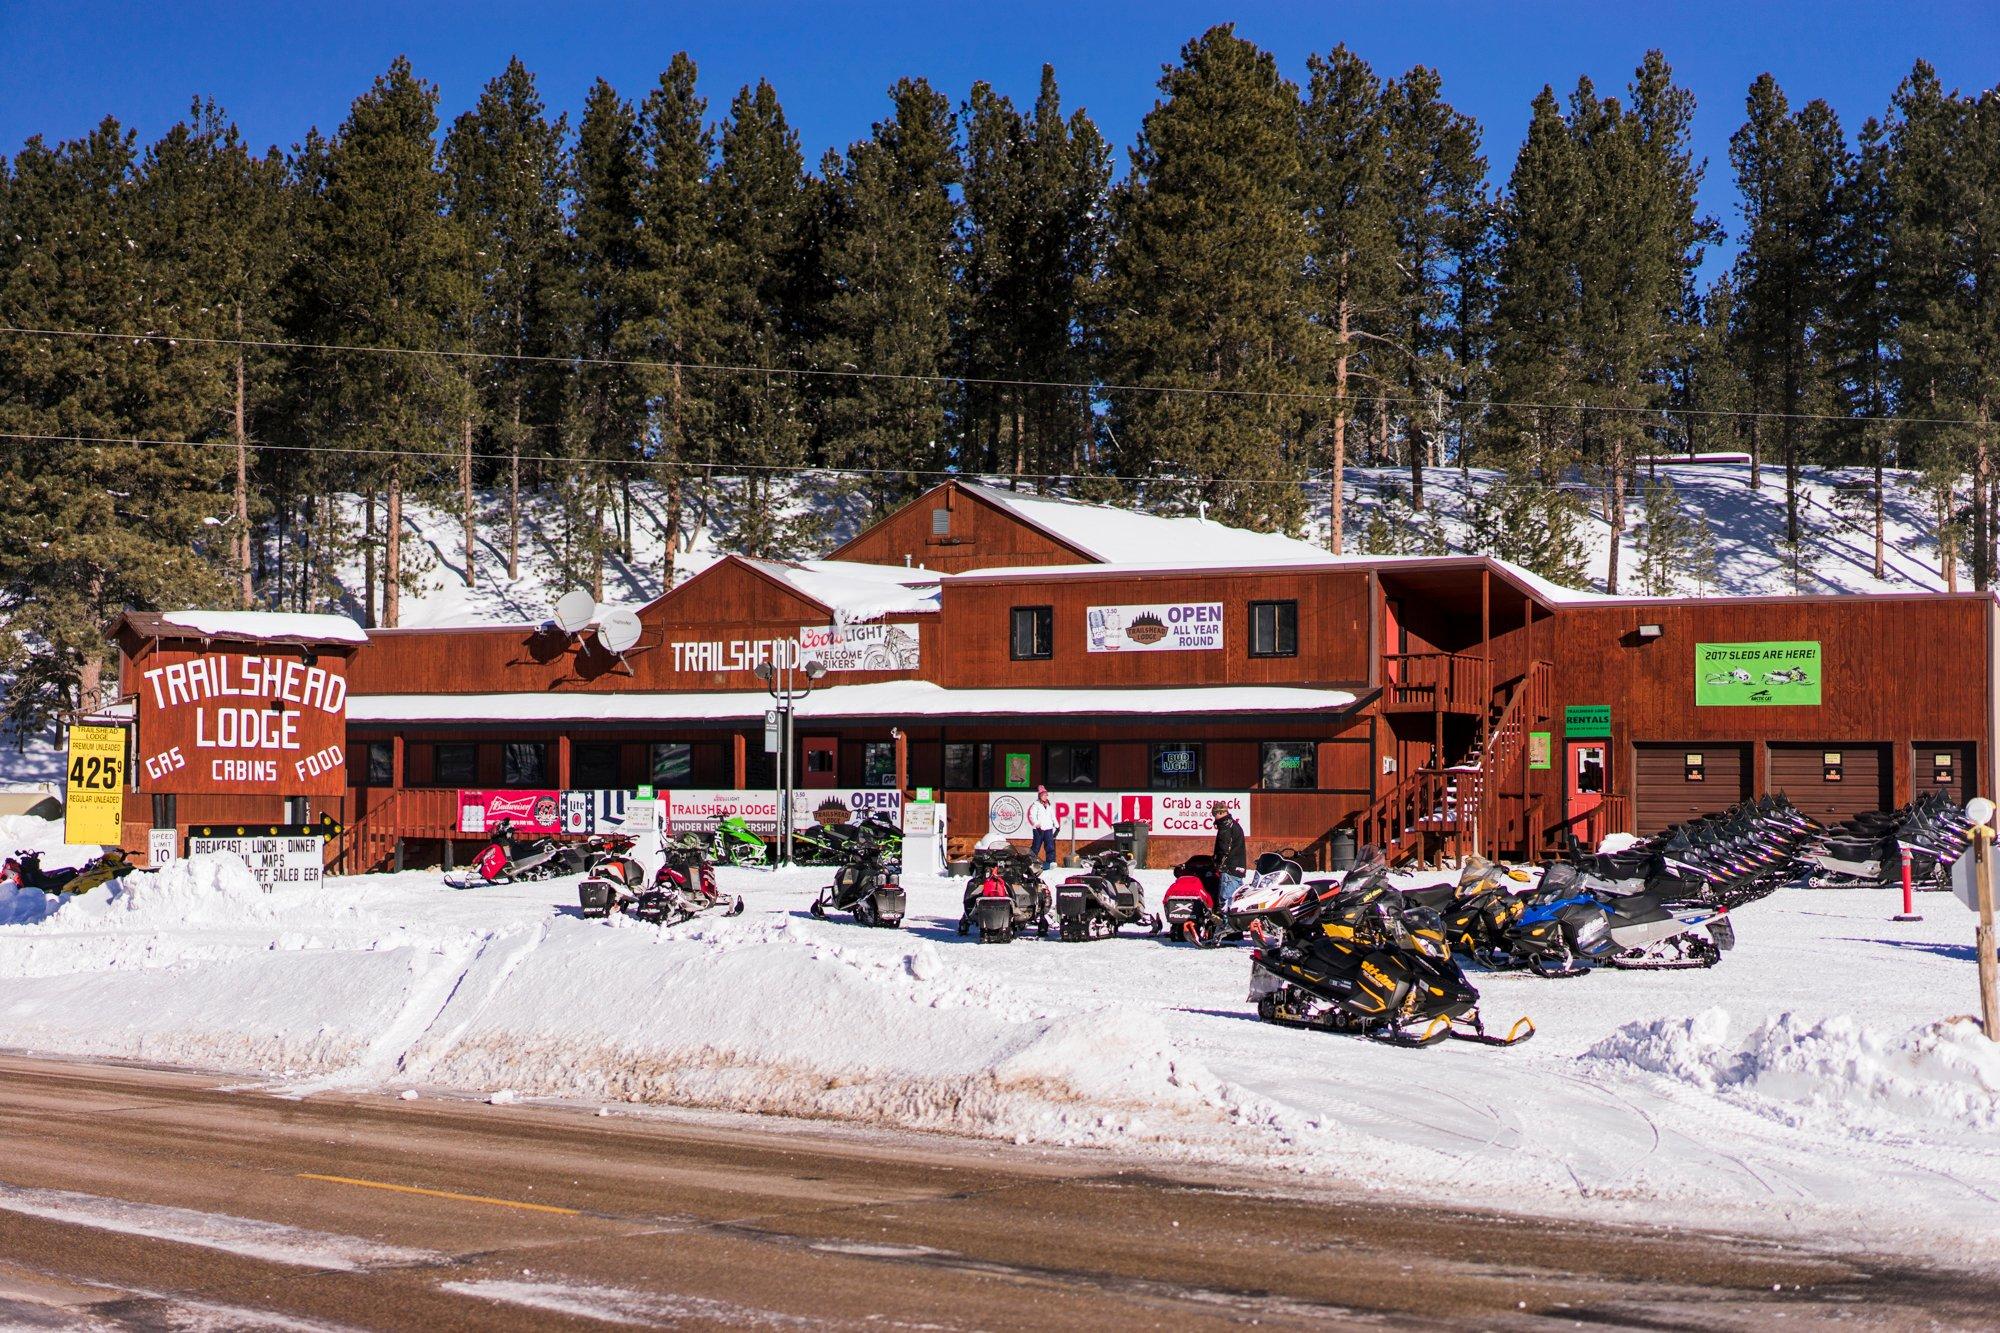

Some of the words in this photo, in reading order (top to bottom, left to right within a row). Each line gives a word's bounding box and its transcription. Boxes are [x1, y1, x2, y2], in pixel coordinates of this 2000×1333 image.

[1167, 605, 1222, 623] OPEN
[845, 625, 883, 642] LIGHT
[1127, 627, 1167, 635] TRAILSHEAD
[1173, 625, 1190, 635] ALL
[1194, 625, 1219, 634] YEAR
[1179, 637, 1214, 647] ROUND
[671, 639, 800, 672] TRAILSHEAD
[815, 650, 863, 660] WELCOME
[1705, 651, 1727, 660] 2017
[1729, 650, 1760, 660] SLEDS
[1762, 650, 1783, 659] ARE
[1785, 649, 1816, 659] HERE!
[823, 659, 856, 669] BIKERS
[144, 655, 346, 714] TRAILSHEAD
[1566, 716, 1609, 724] RENTALS
[78, 727, 119, 735] TRAILSHEAD
[196, 707, 301, 749] LODGE
[72, 742, 95, 750] PREMIUM
[95, 743, 121, 752] UNLEADED
[145, 746, 186, 780] GAS
[295, 745, 344, 782] FOOD
[1168, 753, 1190, 762] BUD
[212, 759, 278, 781] CABINS
[1163, 761, 1193, 770] LIGHT
[70, 756, 117, 789] 425
[69, 794, 93, 803] REGULAR
[93, 795, 120, 804] UNLEADED
[851, 792, 900, 809] OPEN
[1163, 797, 1191, 809] Grab
[1195, 800, 1201, 809] a
[492, 801, 531, 811] Budweiser
[569, 800, 585, 813] Lite
[672, 804, 737, 815] TRAILSHEAD
[740, 804, 776, 815] LODGE
[1028, 802, 1113, 829] PEN
[672, 823, 703, 831] UNDER
[747, 822, 777, 832] ERSHIP
[195, 840, 242, 854] BREAKFAST
[252, 839, 277, 853] LUNCH
[288, 839, 316, 852] DINNER
[155, 849, 170, 863] 10
[262, 854, 285, 868] MAPS
[273, 868, 299, 882] SALEB
[304, 867, 319, 881] EER
